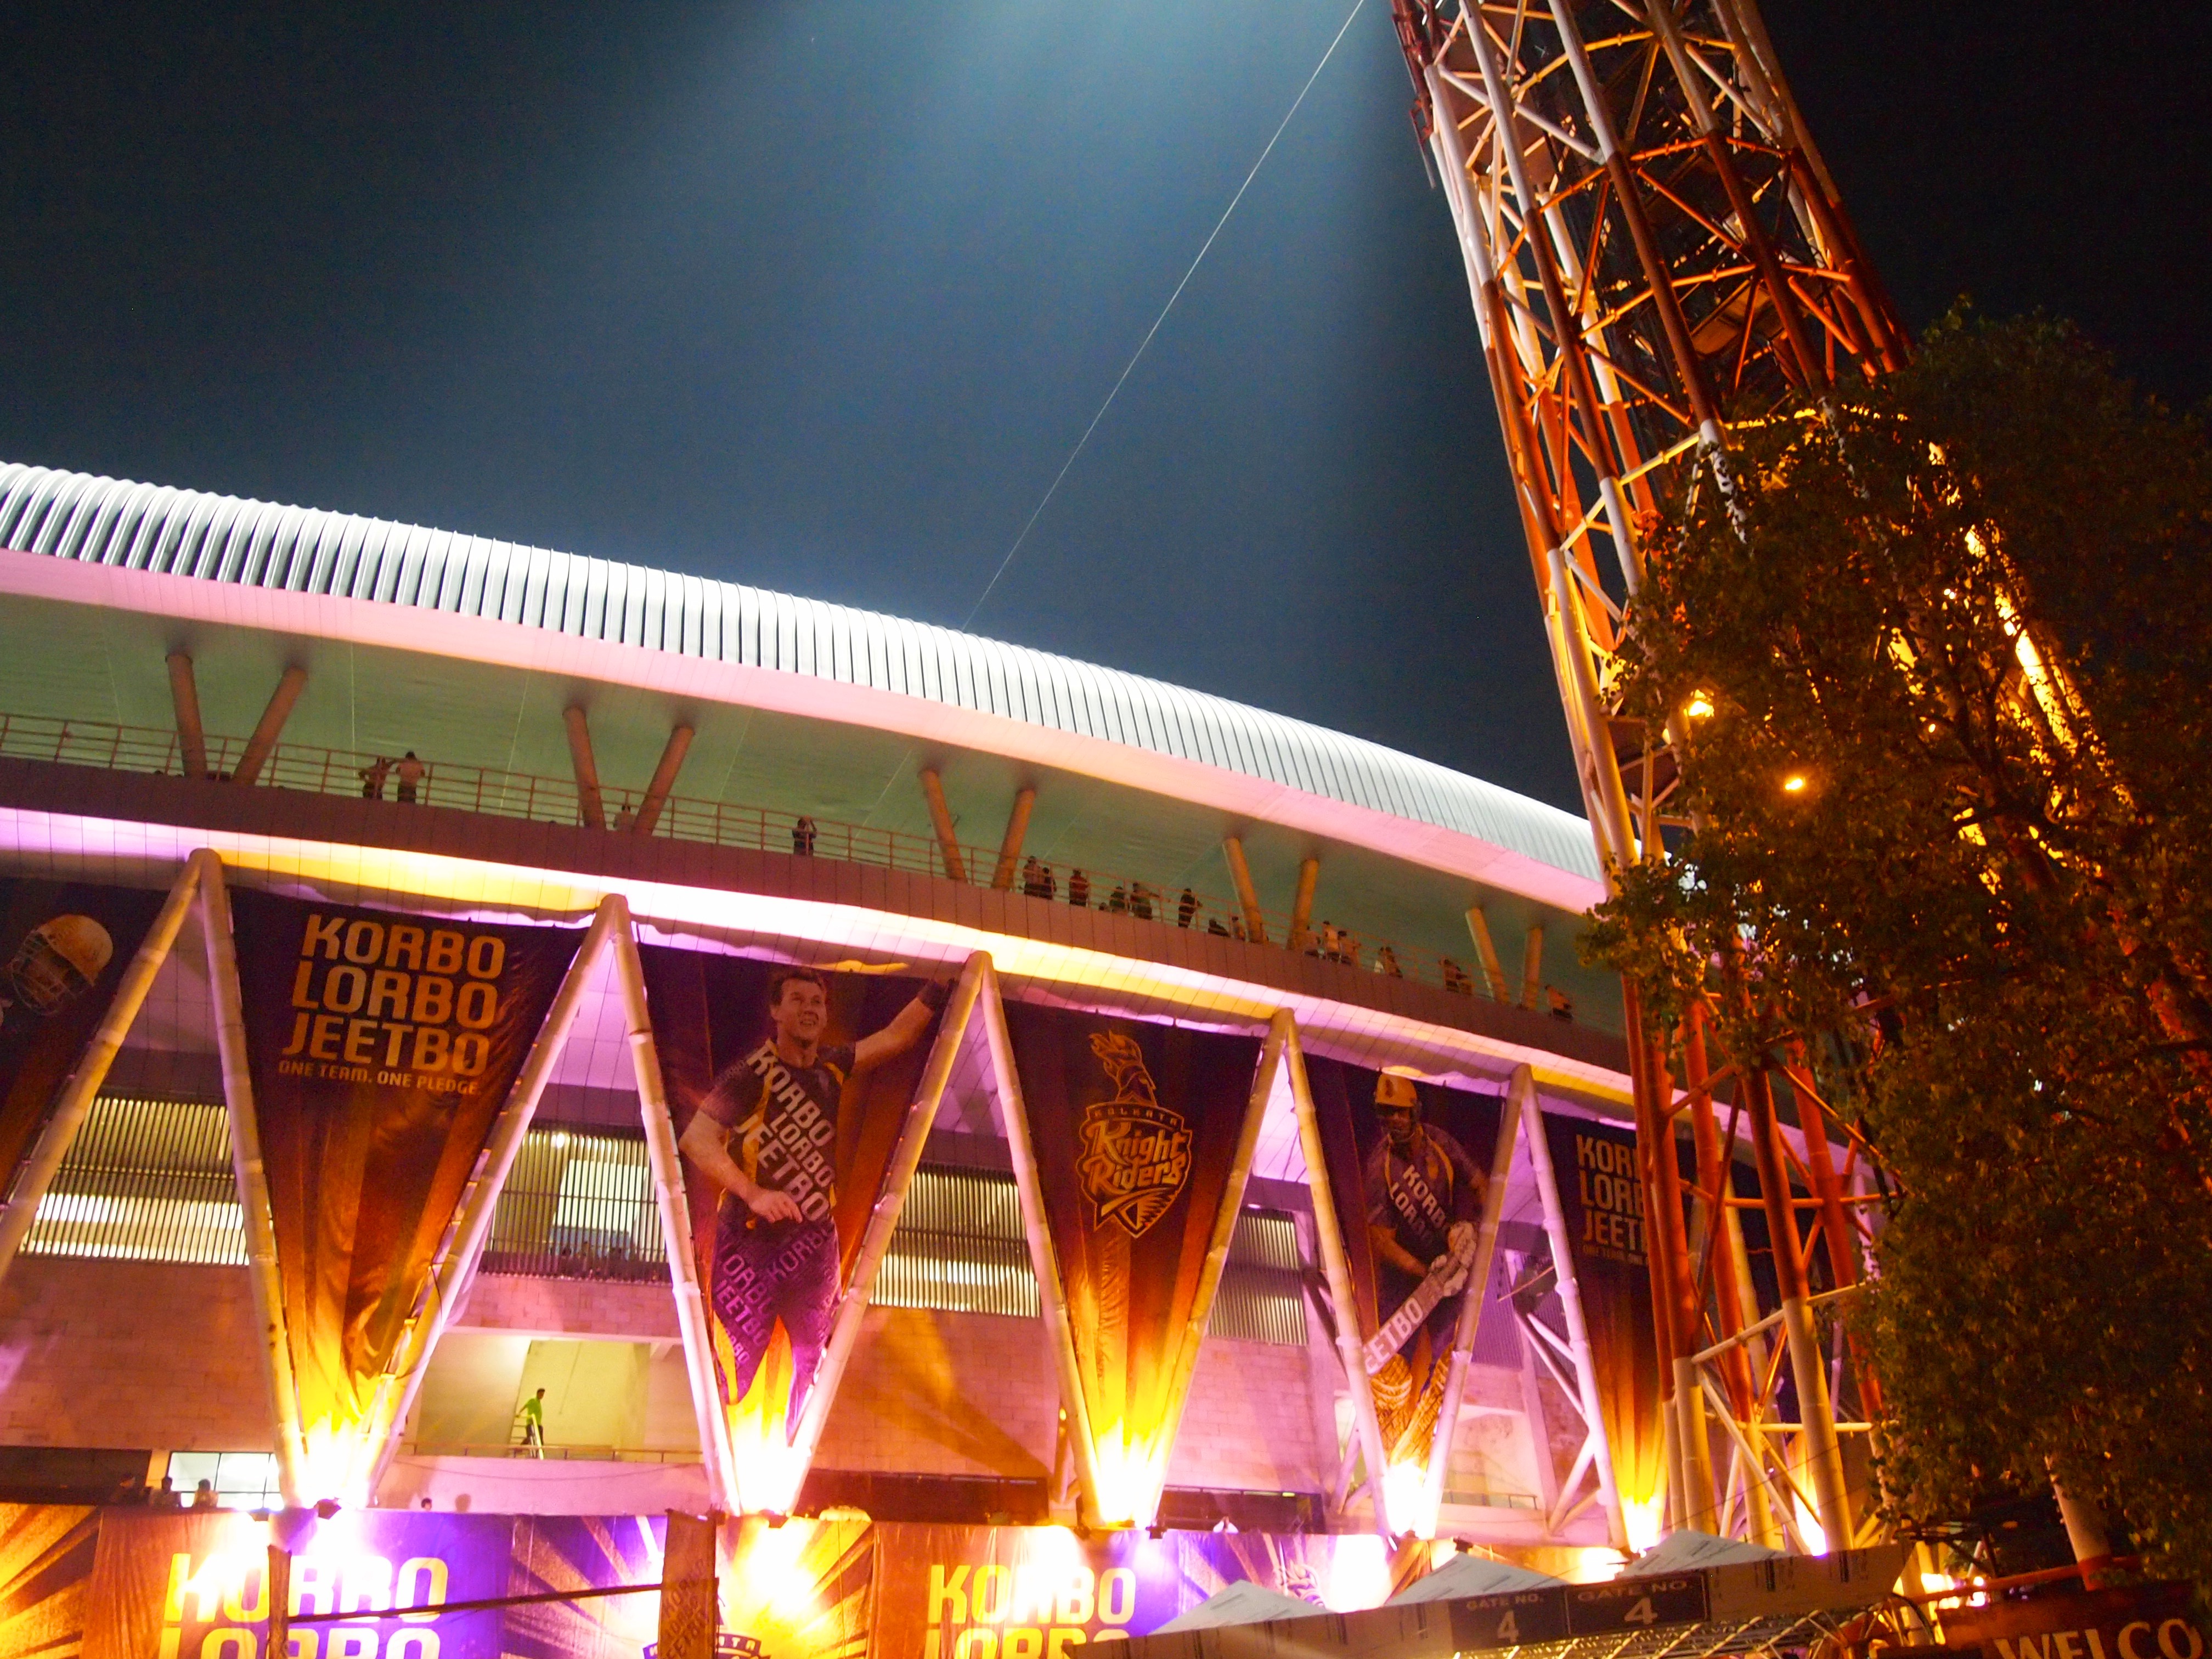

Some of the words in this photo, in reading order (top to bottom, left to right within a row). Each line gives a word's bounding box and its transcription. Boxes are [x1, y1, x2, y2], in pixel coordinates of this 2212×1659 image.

[302, 913, 505, 979] KORBO
[292, 960, 498, 1029] LORBO
[281, 1012, 490, 1076] JEETBO
[278, 1060, 314, 1077] ONE
[377, 1071, 411, 1087] ONE
[747, 1043, 835, 1147] KORBO
[733, 1114, 830, 1221] JEETBO
[770, 1112, 834, 1187] LORBO
[1086, 1121, 1187, 1166] Knight
[1576, 1134, 1641, 1182] KOR
[1083, 1152, 1187, 1195] Riders
[927, 1565, 1136, 1624] KORBO
[1466, 1598, 1509, 1611] GATE
[1515, 1593, 1544, 1604] NO.
[1577, 1584, 1641, 1601] GATE
[1624, 1597, 1658, 1624] 4
[1497, 1609, 1519, 1644] 4
